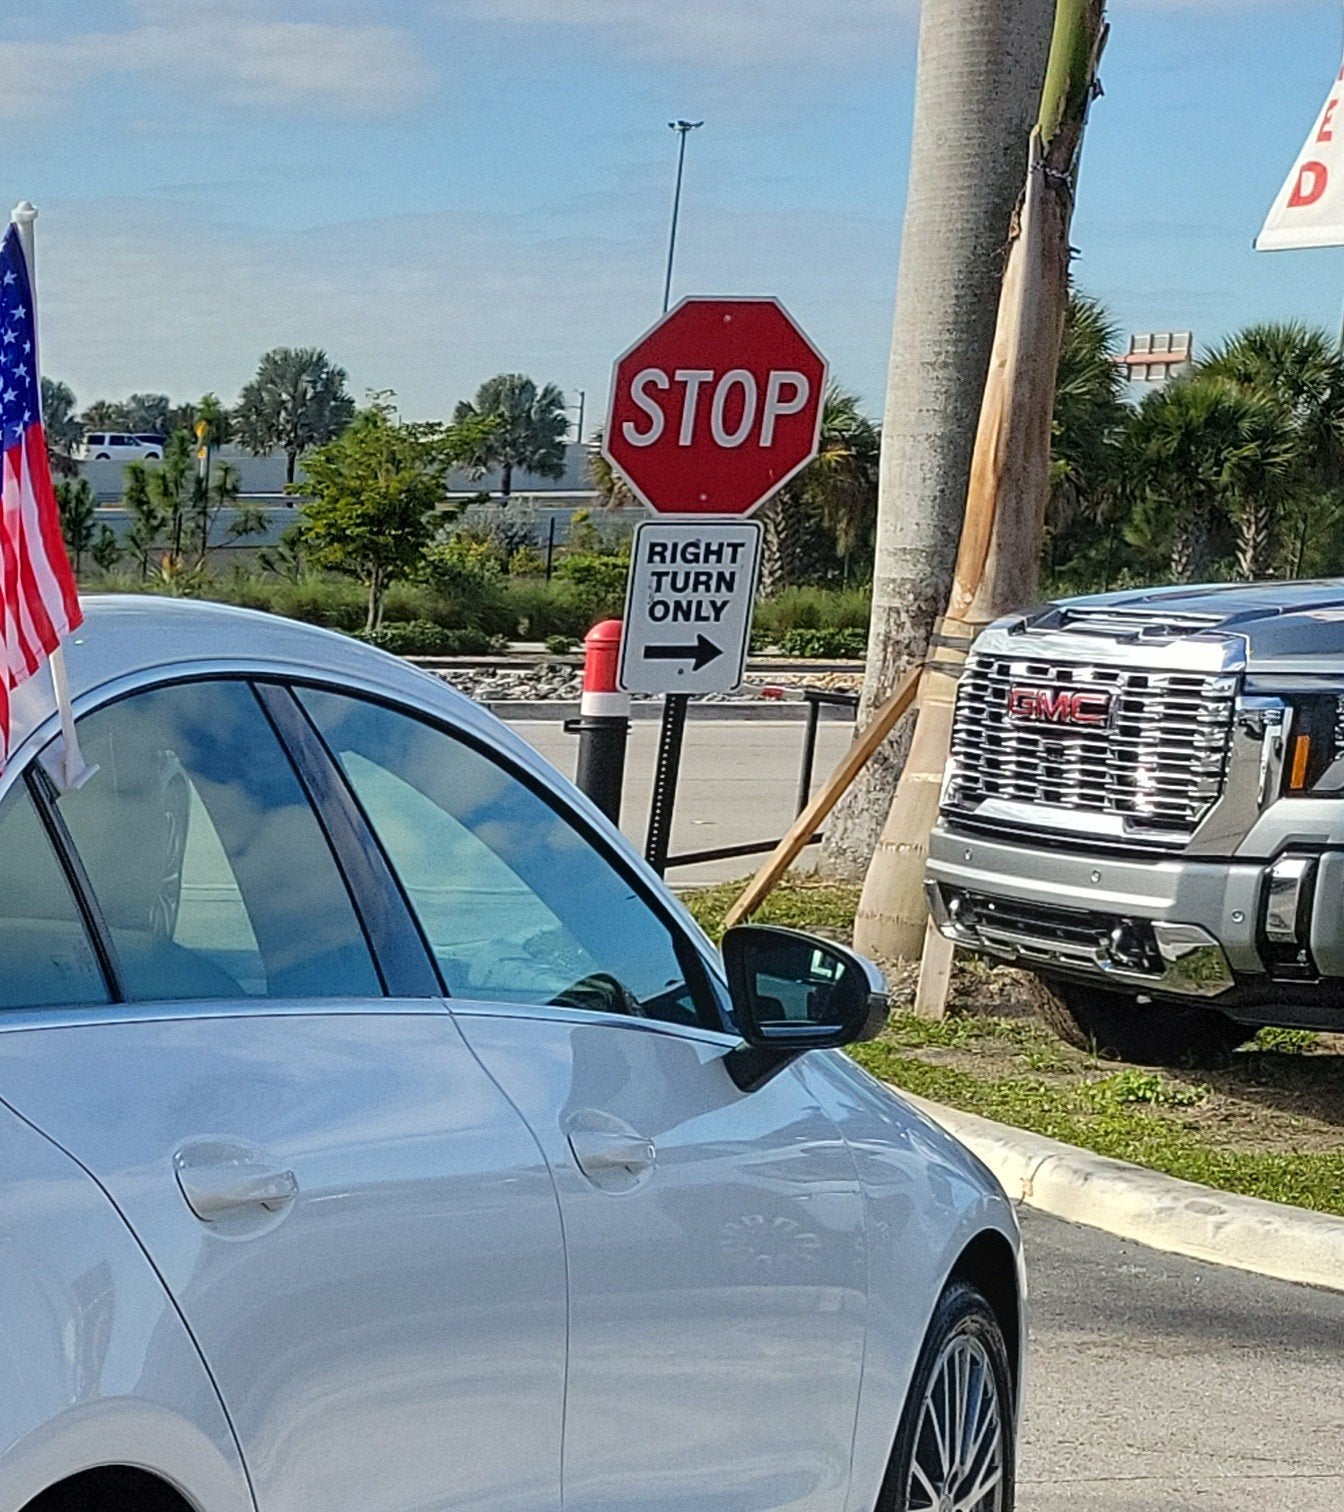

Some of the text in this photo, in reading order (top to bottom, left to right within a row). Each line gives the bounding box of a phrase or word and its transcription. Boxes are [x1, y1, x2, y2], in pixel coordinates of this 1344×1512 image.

[622, 367, 810, 448] STOP
[647, 541, 746, 564] RIGHT
[650, 571, 736, 593] TURN
[648, 600, 731, 622] ONLY
[1008, 686, 1110, 726] GMC
